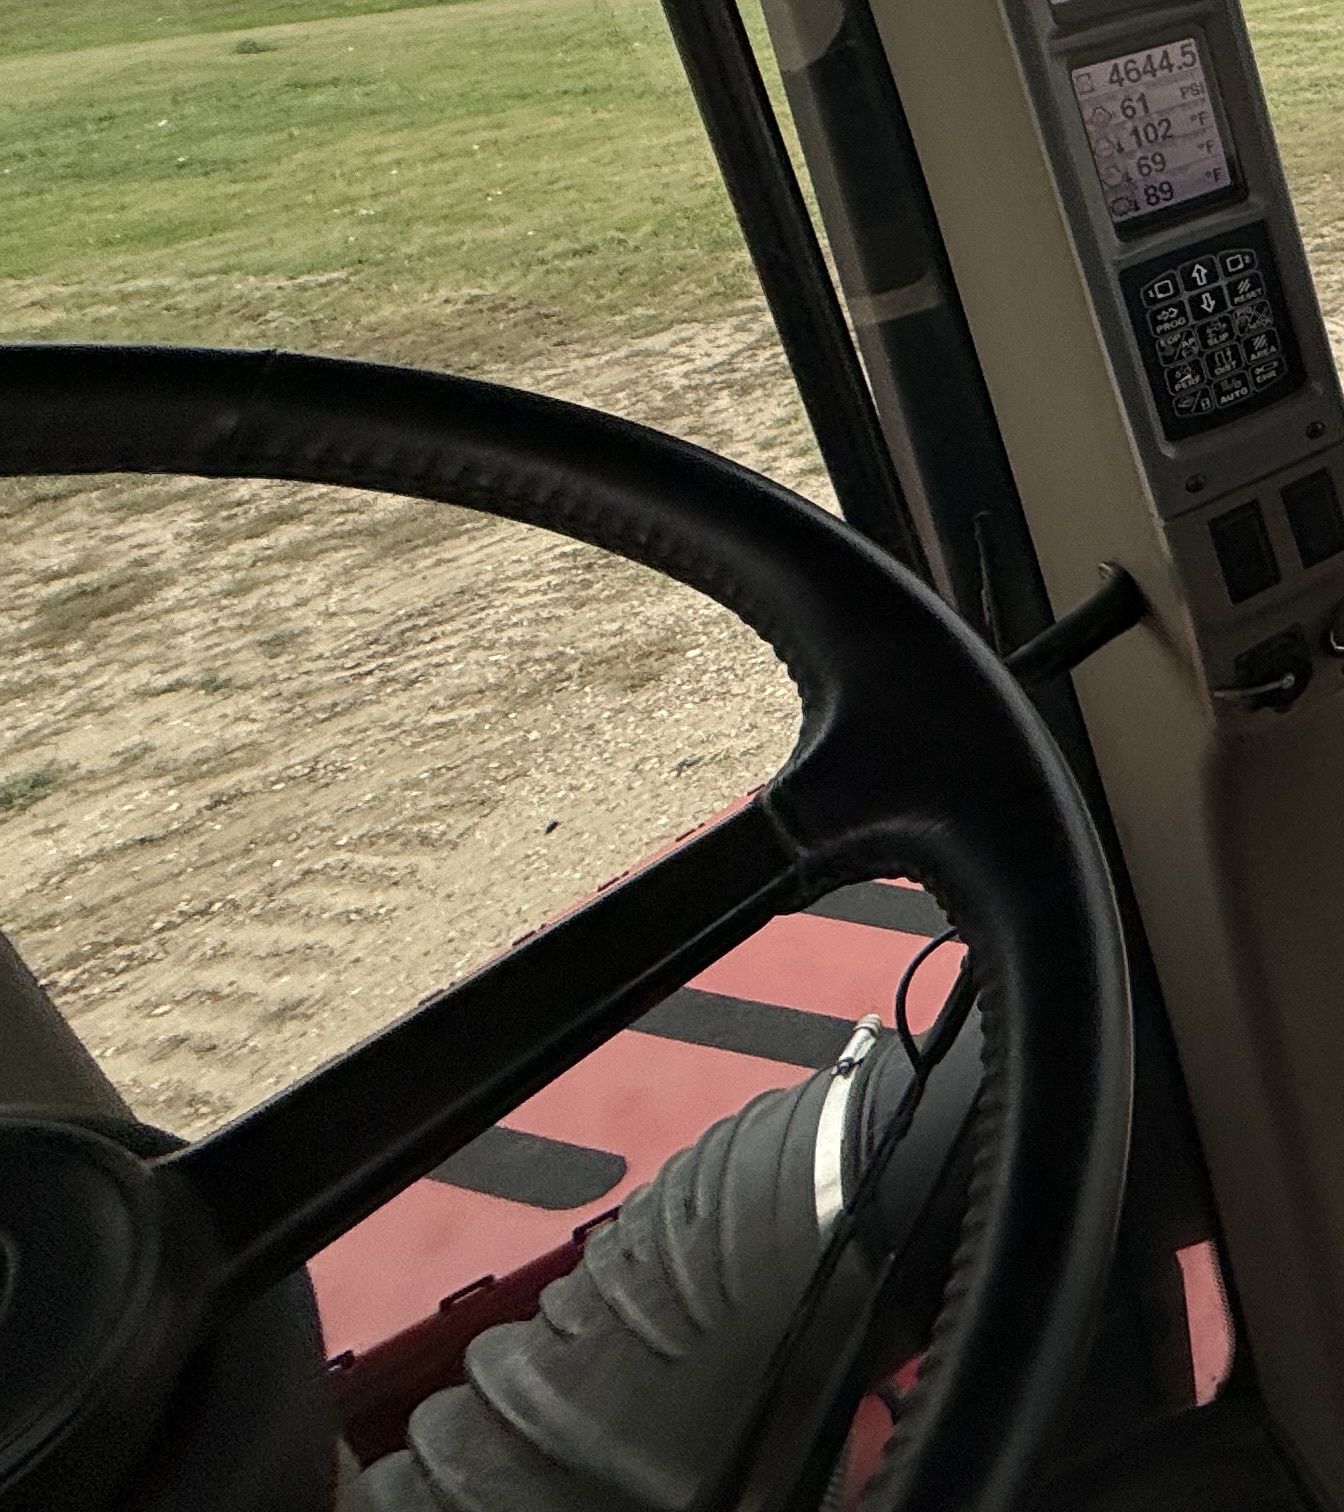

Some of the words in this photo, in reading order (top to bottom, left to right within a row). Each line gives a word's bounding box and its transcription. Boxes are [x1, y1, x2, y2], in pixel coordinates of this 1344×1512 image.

[1108, 42, 1196, 87] 4644.5
[1120, 92, 1150, 120] 61
[1179, 81, 1207, 99] PSI
[1130, 118, 1173, 148] 102
[1136, 151, 1167, 177] 69
[1144, 180, 1174, 206] 89
[1233, 288, 1263, 306] RESET
[1156, 317, 1187, 335] PROG
[1207, 332, 1230, 348] SLIP
[1249, 345, 1278, 362] AREA
[1174, 374, 1202, 393] PERF
[1219, 386, 1249, 405] AUTO
